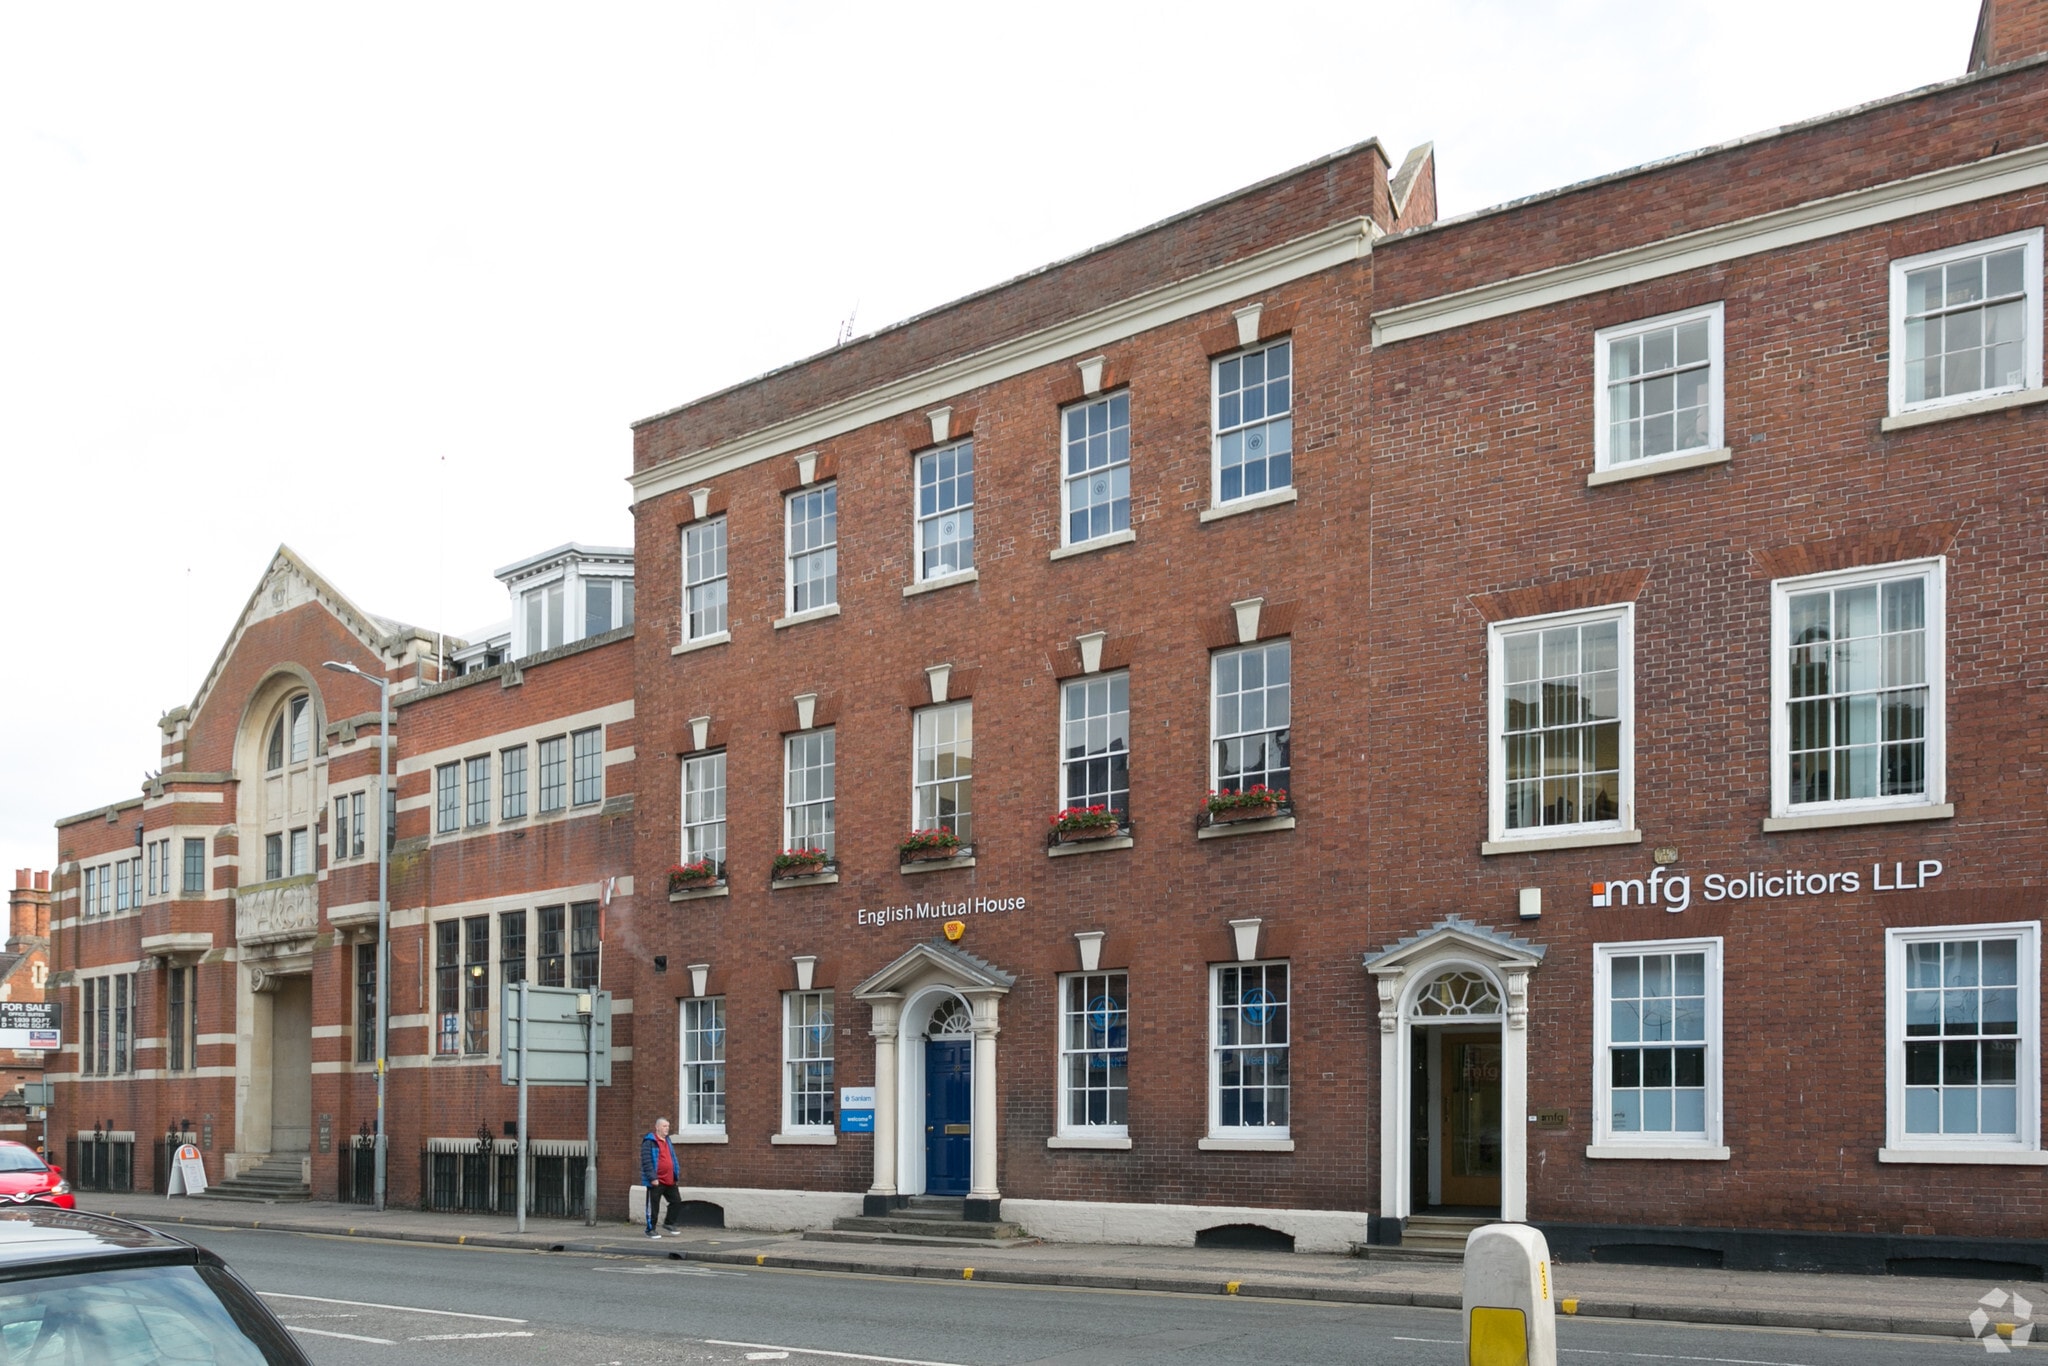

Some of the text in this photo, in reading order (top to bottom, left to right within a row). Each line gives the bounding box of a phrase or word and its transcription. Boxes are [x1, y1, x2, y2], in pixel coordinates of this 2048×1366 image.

[1605, 859, 1943, 913] mfg Solicitors LLP
[858, 896, 1026, 927] English Mutual House
[1, 1003, 52, 1012] FOR SALE
[1544, 1112, 1564, 1122] mfg
